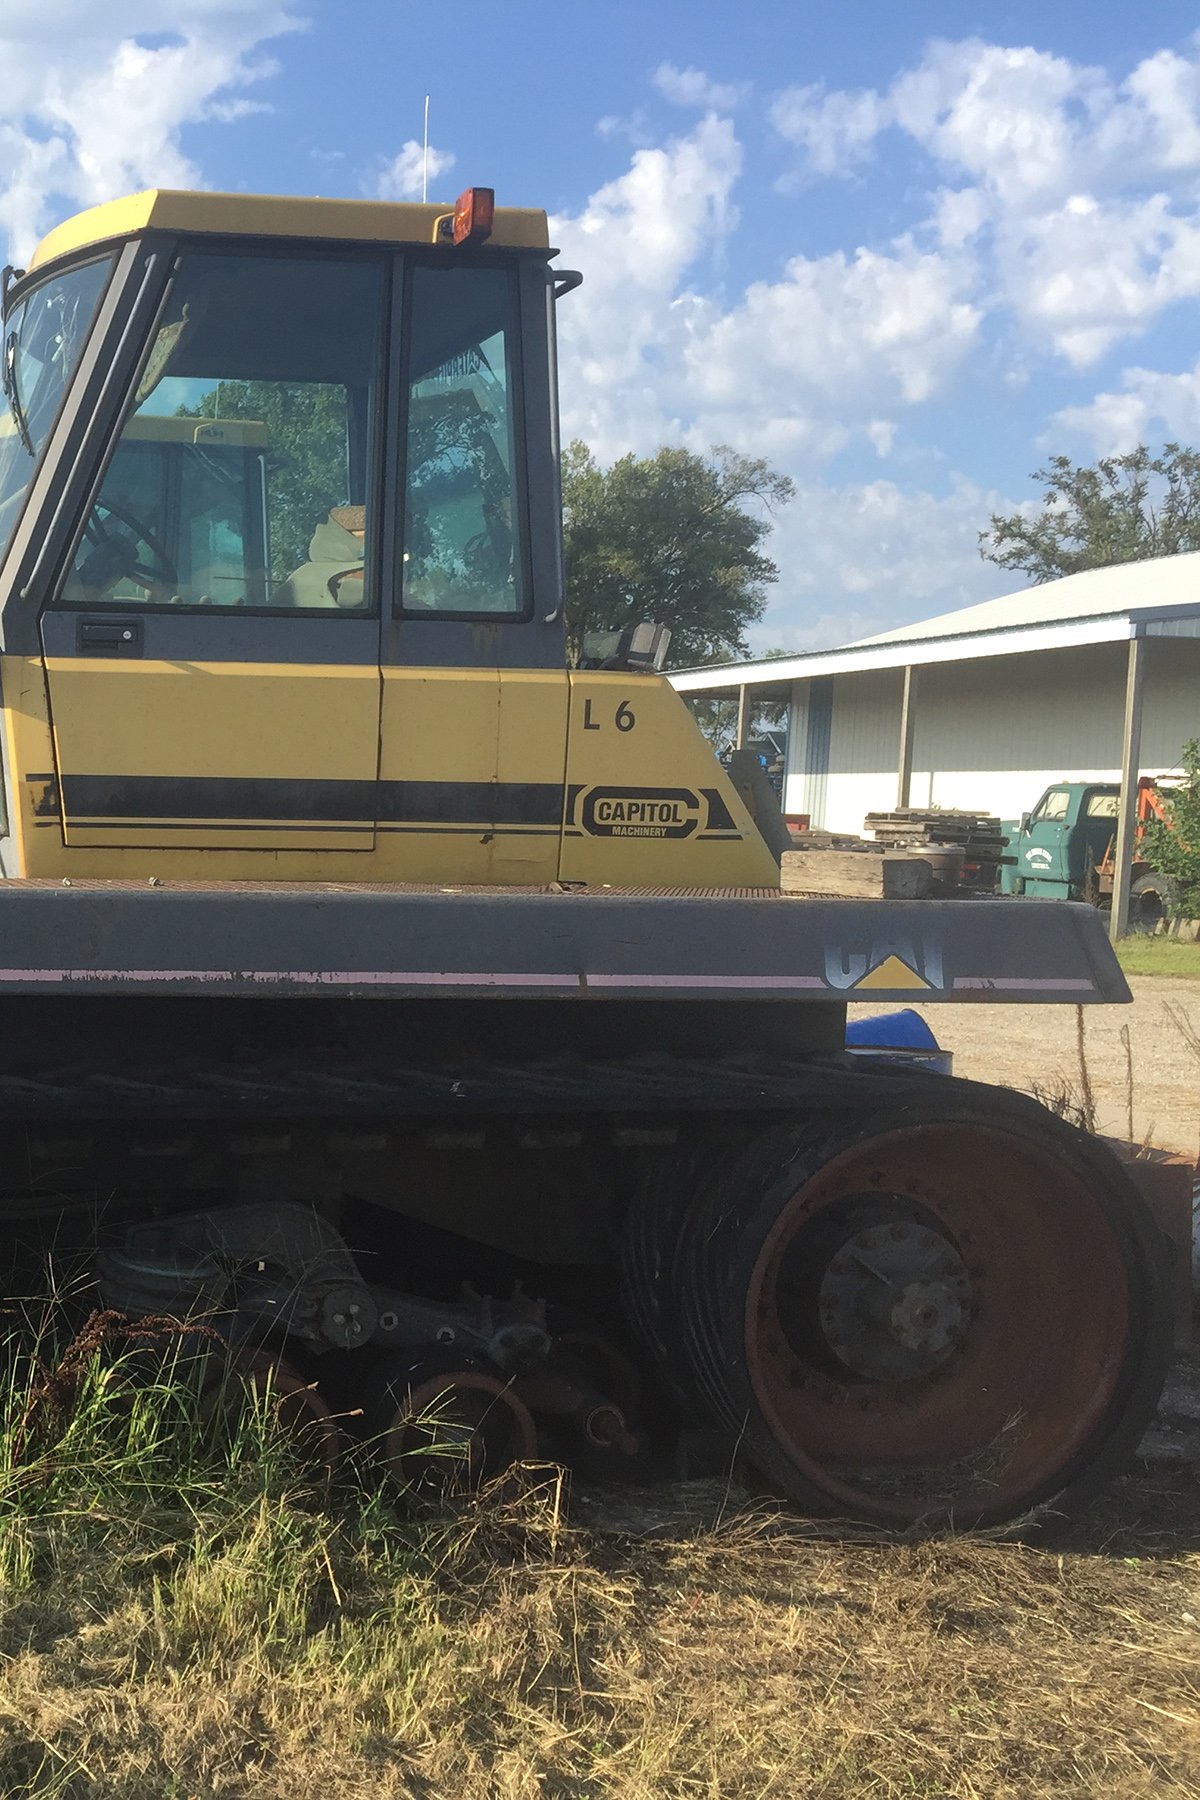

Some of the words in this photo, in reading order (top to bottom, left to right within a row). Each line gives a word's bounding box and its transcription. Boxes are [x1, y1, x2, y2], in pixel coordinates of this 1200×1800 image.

[584, 699, 600, 730] L
[615, 700, 635, 732] 6
[598, 802, 683, 823] CAPITOL
[611, 826, 667, 837] MACHINERY
